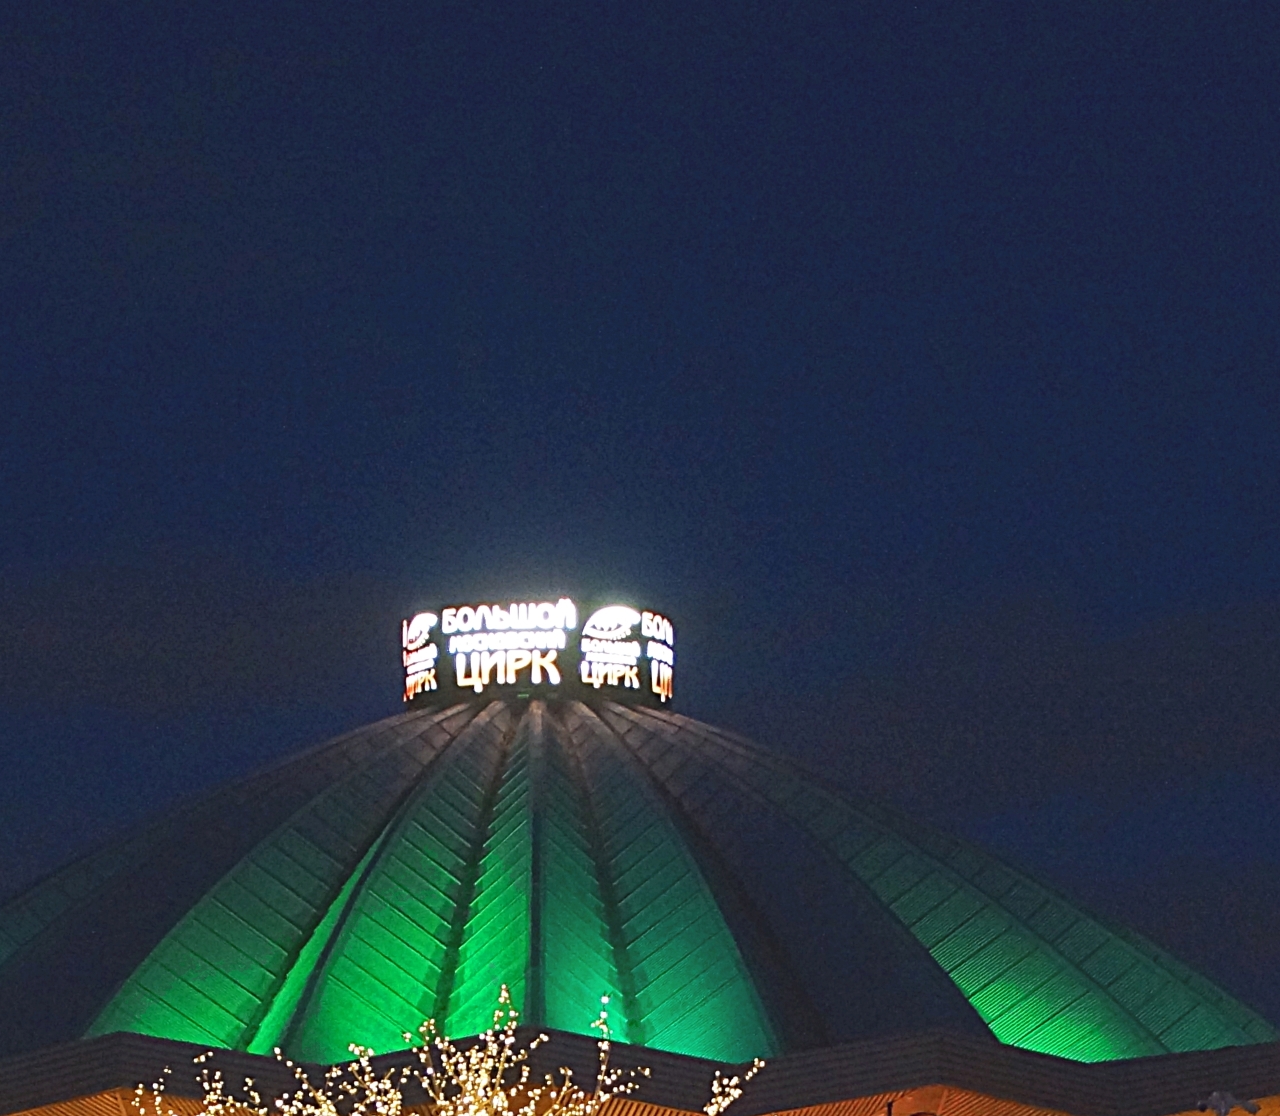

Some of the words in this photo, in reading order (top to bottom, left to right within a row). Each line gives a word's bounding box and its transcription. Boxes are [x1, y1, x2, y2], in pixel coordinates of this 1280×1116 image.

[441, 598, 577, 634] БОЛЬШОЙ
[455, 649, 561, 693] ЦИРК
[581, 660, 640, 689] ЦИРК
